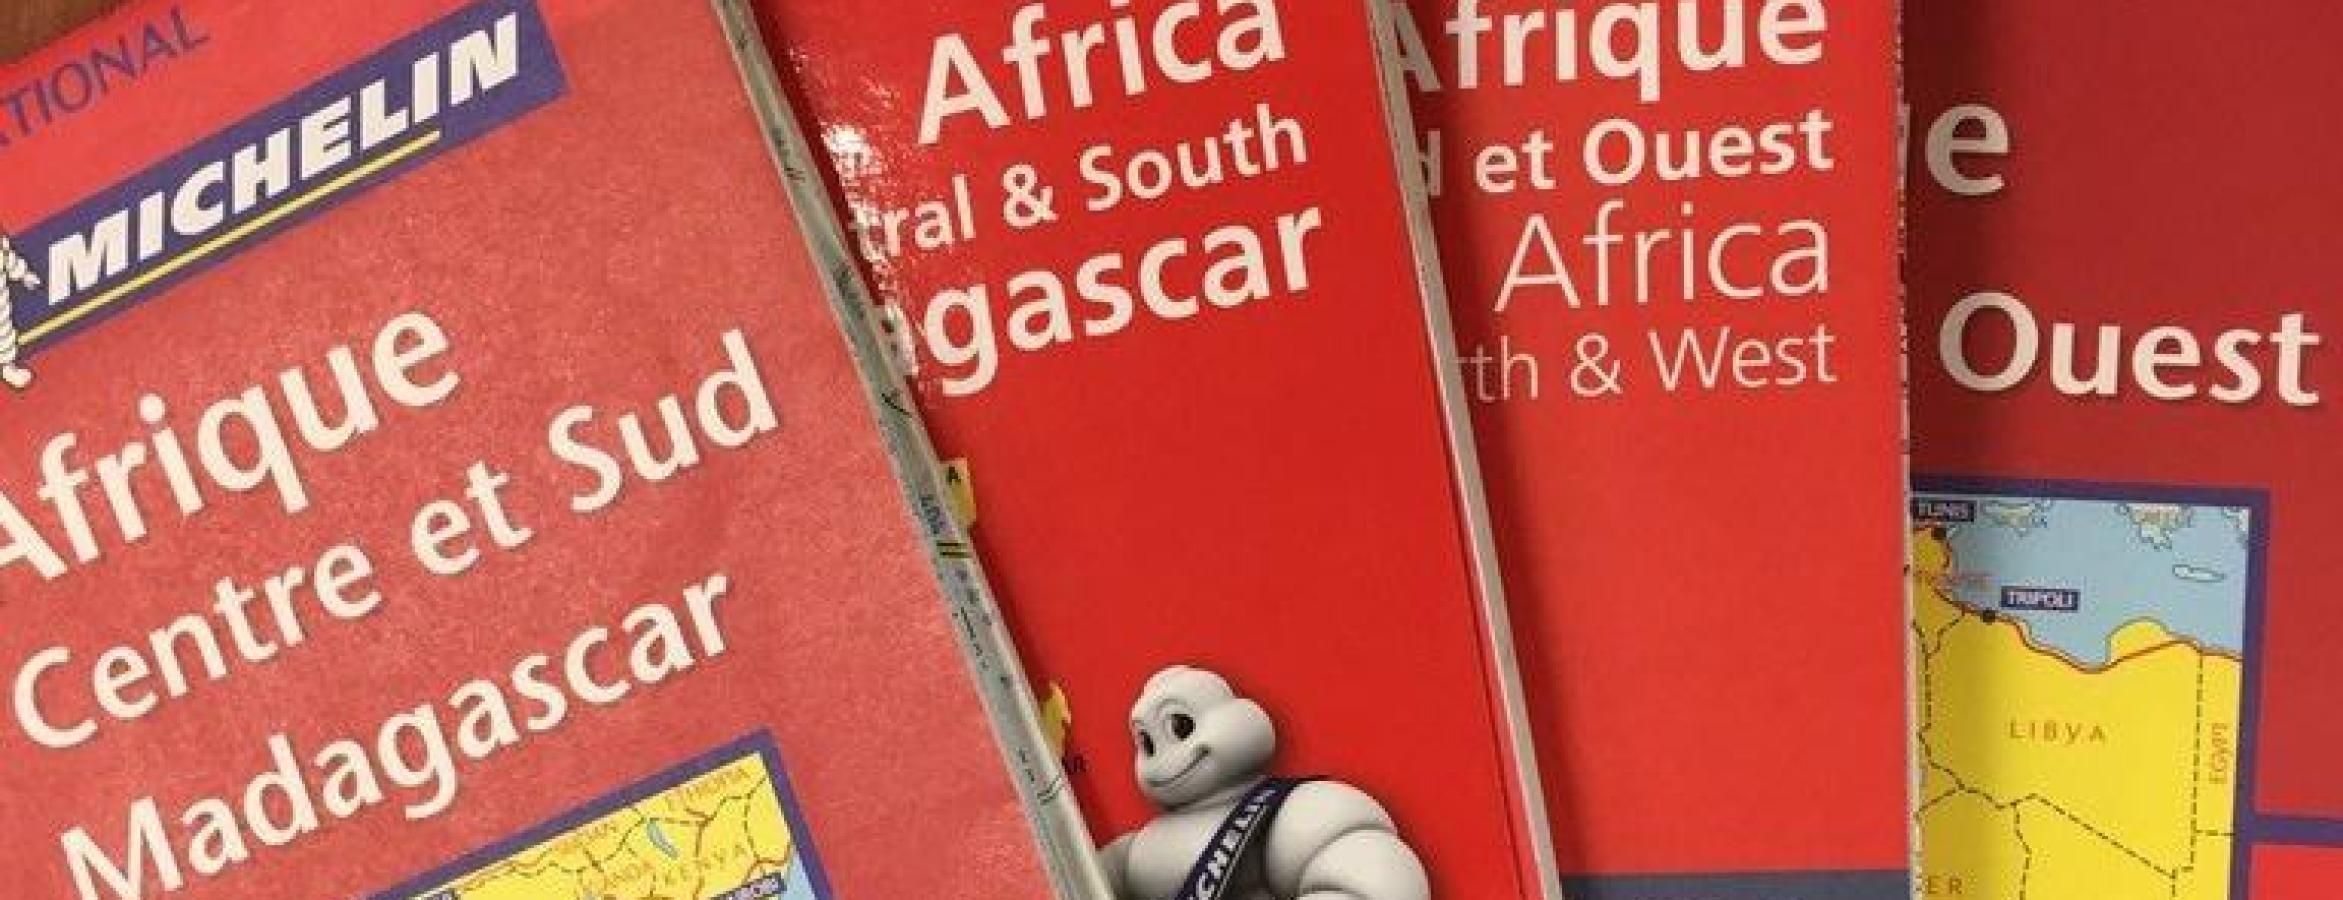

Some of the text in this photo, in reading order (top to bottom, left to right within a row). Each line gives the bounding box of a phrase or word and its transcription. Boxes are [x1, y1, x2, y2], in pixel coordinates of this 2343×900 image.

[0, 4, 211, 146] TIONAL
[917, 0, 1286, 145] Africa
[48, 12, 519, 305] MICHELIN
[1001, 164, 1056, 229] &
[1079, 103, 1307, 212] South
[1474, 129, 1556, 193] et
[1583, 109, 1834, 186] Ouest
[1900, 102, 2010, 196] e
[1494, 200, 1830, 312] Africa
[1456, 325, 1837, 403] th & West
[1939, 291, 2321, 406] Ouest
[0, 311, 461, 580] Afrique
[13, 329, 778, 748] Centre et Sud
[2006, 590, 2074, 606] TRIPOLI
[60, 573, 731, 900] Madagascar
[2008, 716, 2106, 745] LIBYA
[1187, 789, 1276, 900] CHELIN
[1921, 874, 1964, 896] ER
